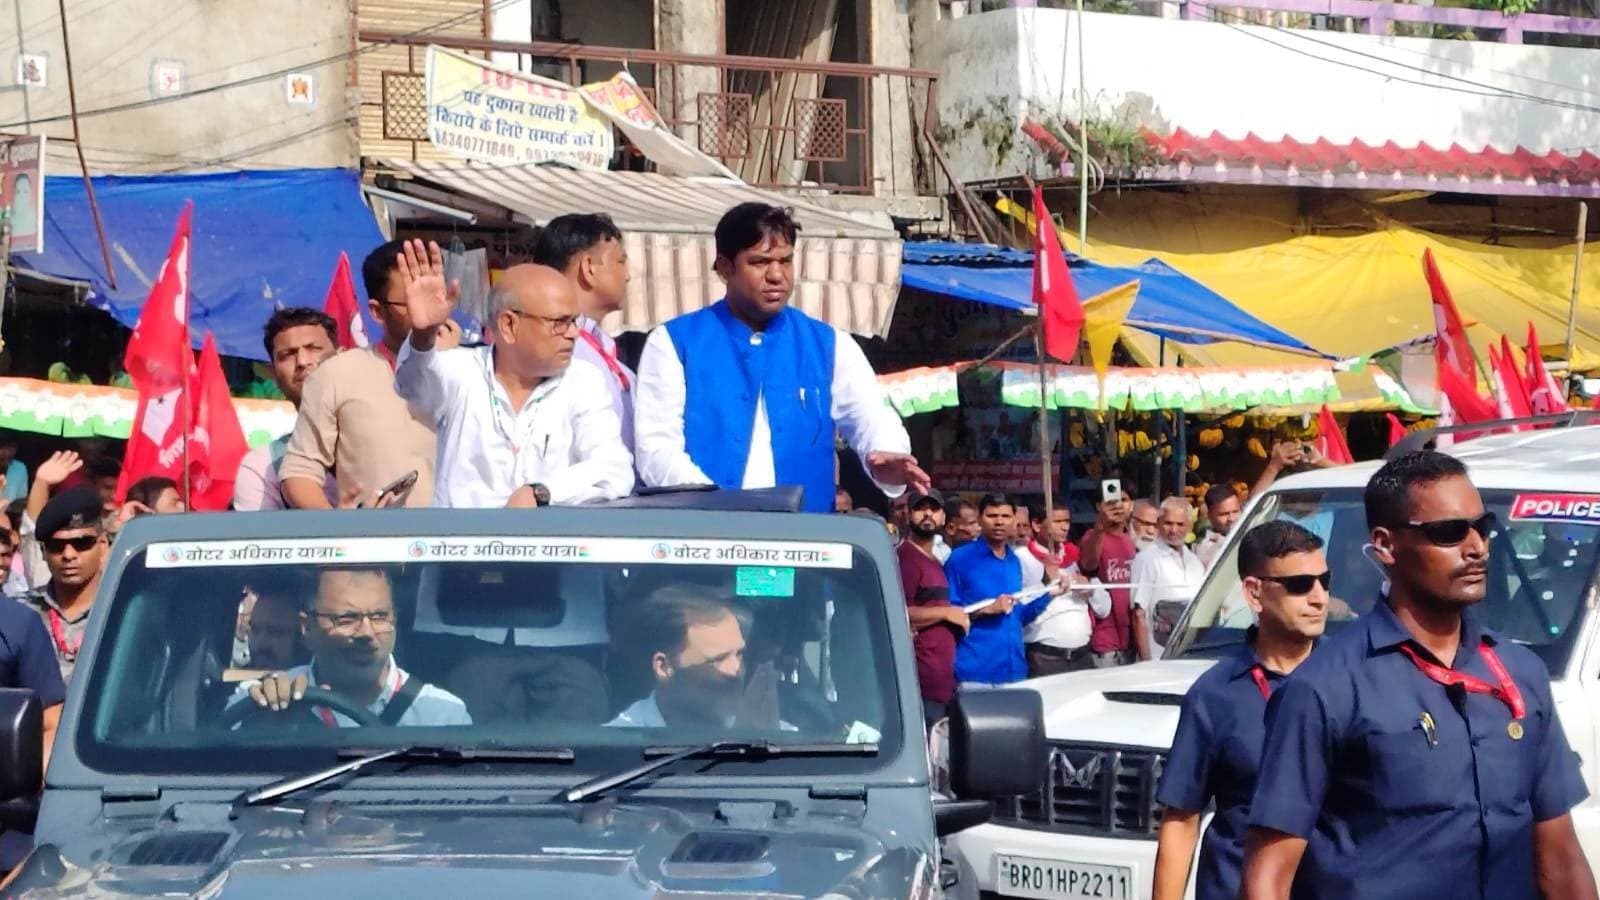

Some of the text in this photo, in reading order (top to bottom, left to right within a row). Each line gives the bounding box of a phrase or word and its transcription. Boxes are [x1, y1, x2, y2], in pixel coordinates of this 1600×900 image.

[486, 94, 524, 114] दुकान
[529, 101, 566, 122] खाली
[568, 106, 579, 125] है
[479, 115, 492, 132] के
[1520, 500, 1600, 518] POLICE
[186, 544, 334, 560] वोटर अधिकार यात्रा
[431, 540, 578, 558] वोटर अधिकार यात्रा
[673, 544, 820, 562] वोटर अधिकार यात्रा
[1010, 863, 1126, 900] BR01HP2211
